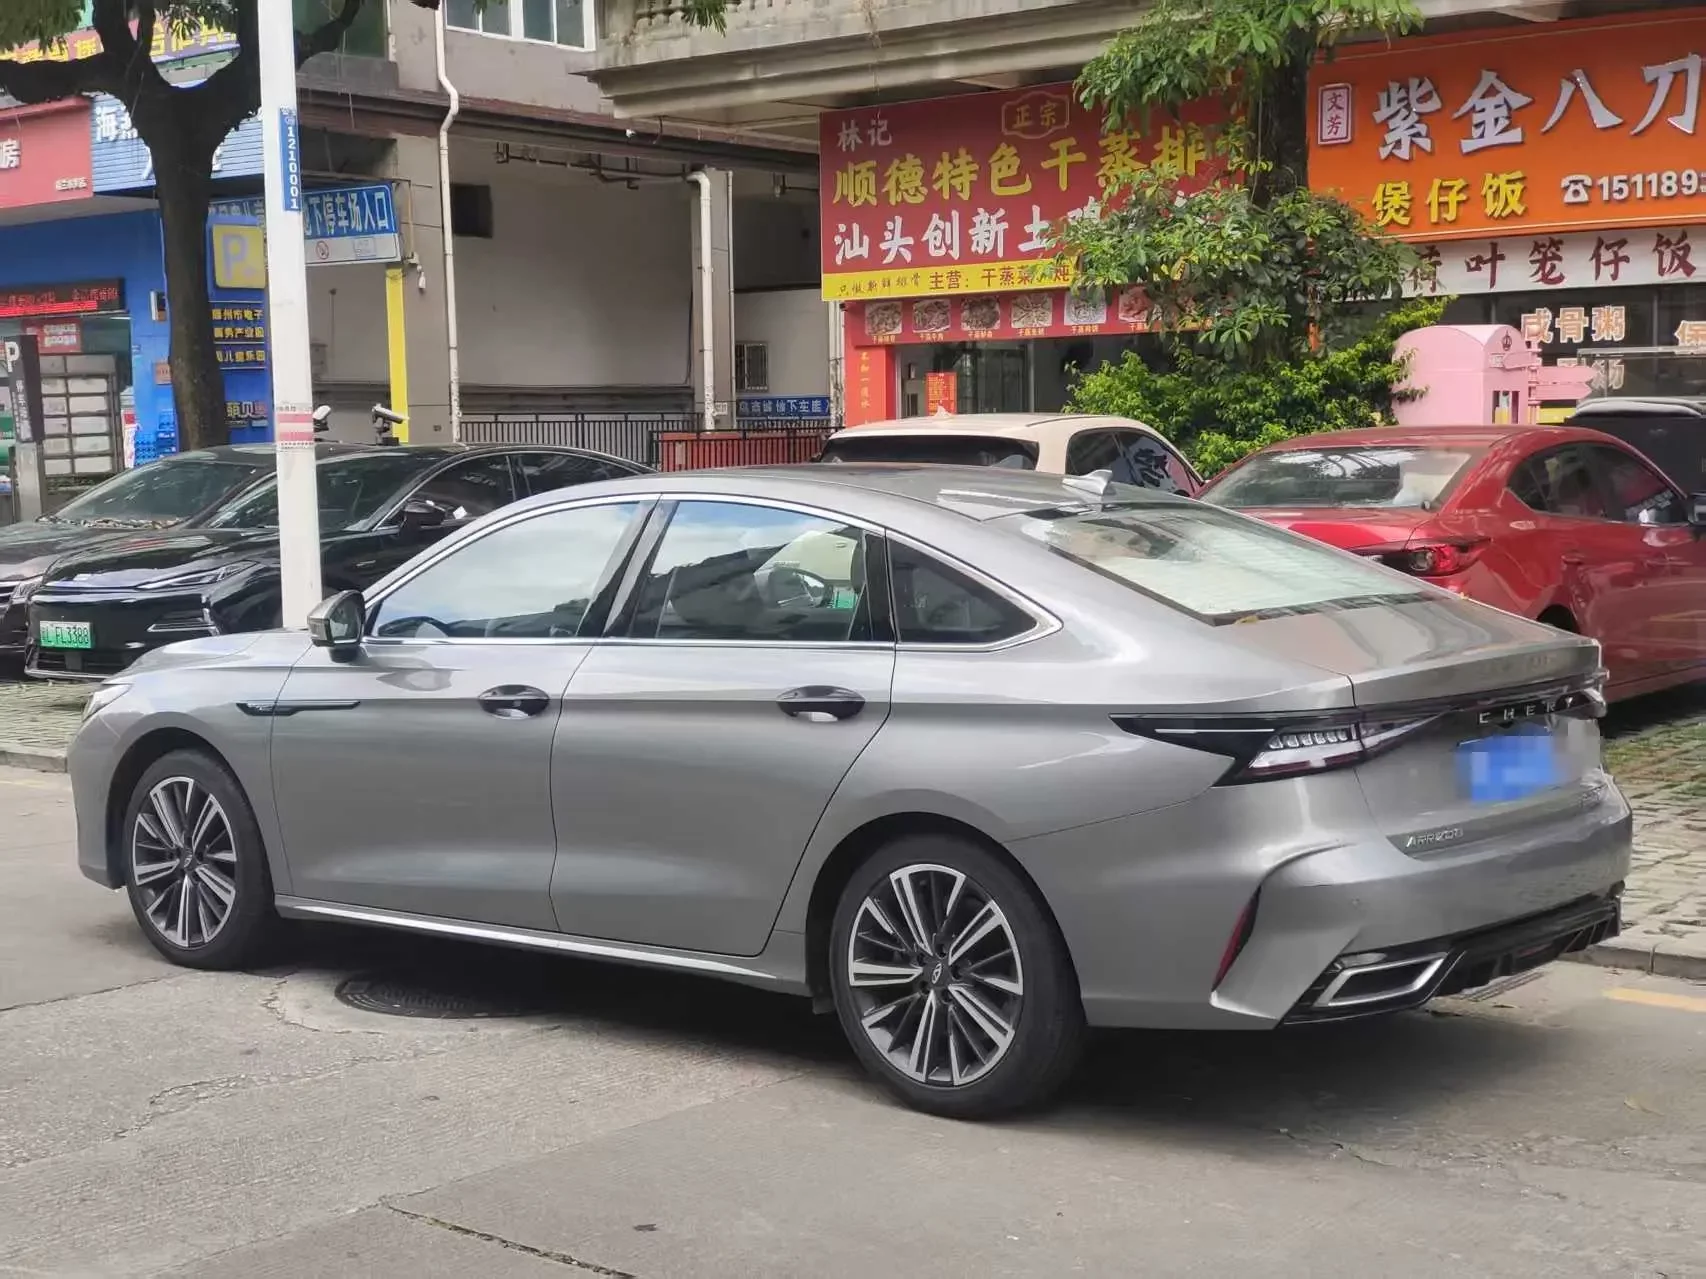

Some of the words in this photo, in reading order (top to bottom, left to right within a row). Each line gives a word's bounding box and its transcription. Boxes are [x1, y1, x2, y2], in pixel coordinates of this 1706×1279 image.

[1013, 100, 1059, 128] 正宗
[1327, 91, 1345, 136] 文芳
[1372, 53, 1701, 161] 紫金八刀
[837, 118, 893, 152] 林记
[287, 126, 299, 209] 1210001
[1372, 170, 1528, 227] 煲仔饭
[1479, 696, 1573, 723] CHERY
